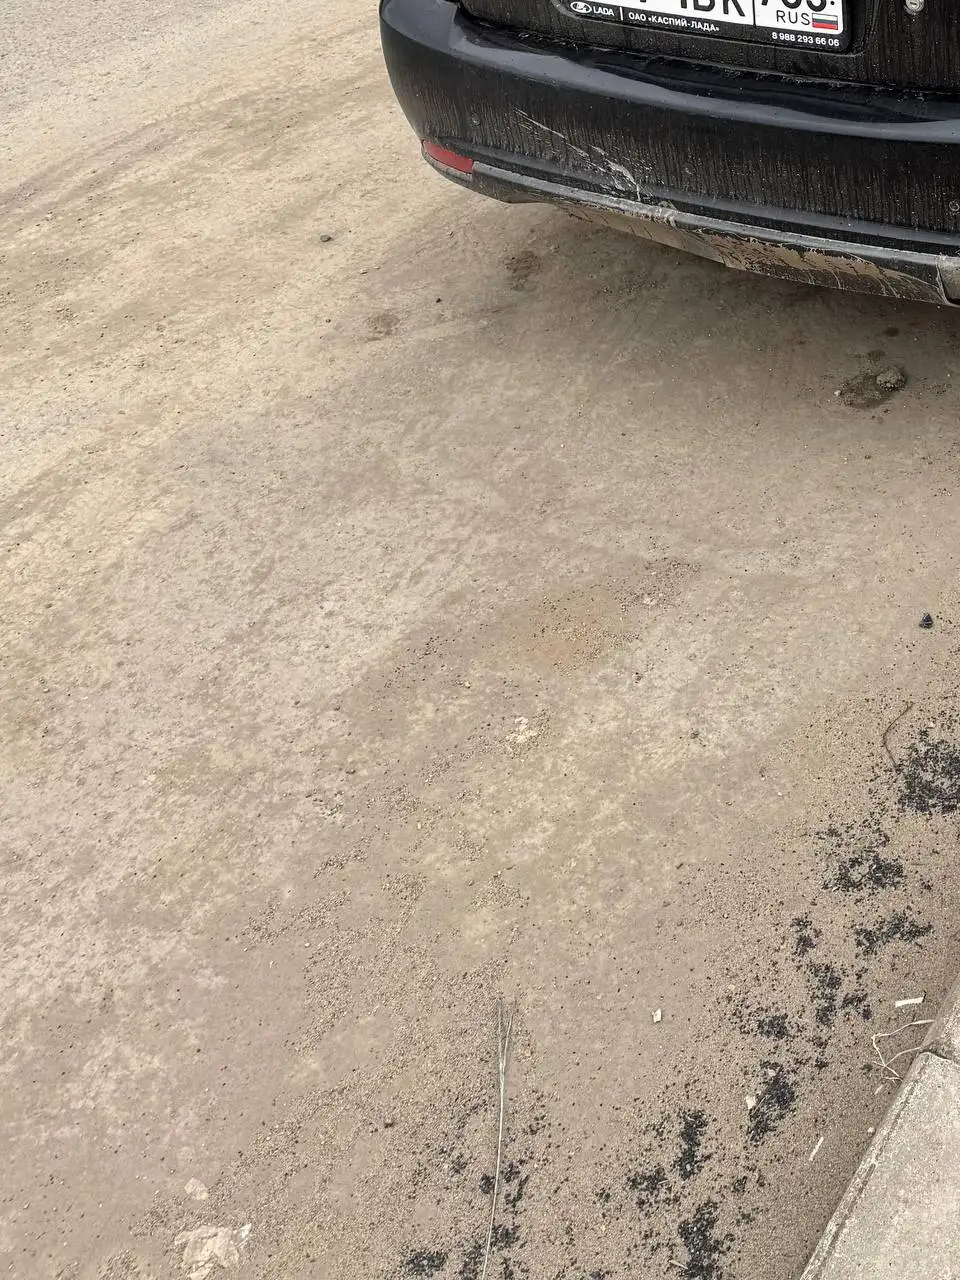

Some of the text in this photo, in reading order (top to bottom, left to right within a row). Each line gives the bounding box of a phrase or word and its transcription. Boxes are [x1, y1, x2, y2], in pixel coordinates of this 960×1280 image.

[592, 6, 615, 16] LADA
[776, 9, 810, 26] RUS
[628, 12, 720, 32] ОАО «КАСПИЙ-ЛАДА»
[771, 31, 840, 47] 8 988 293 66 06
